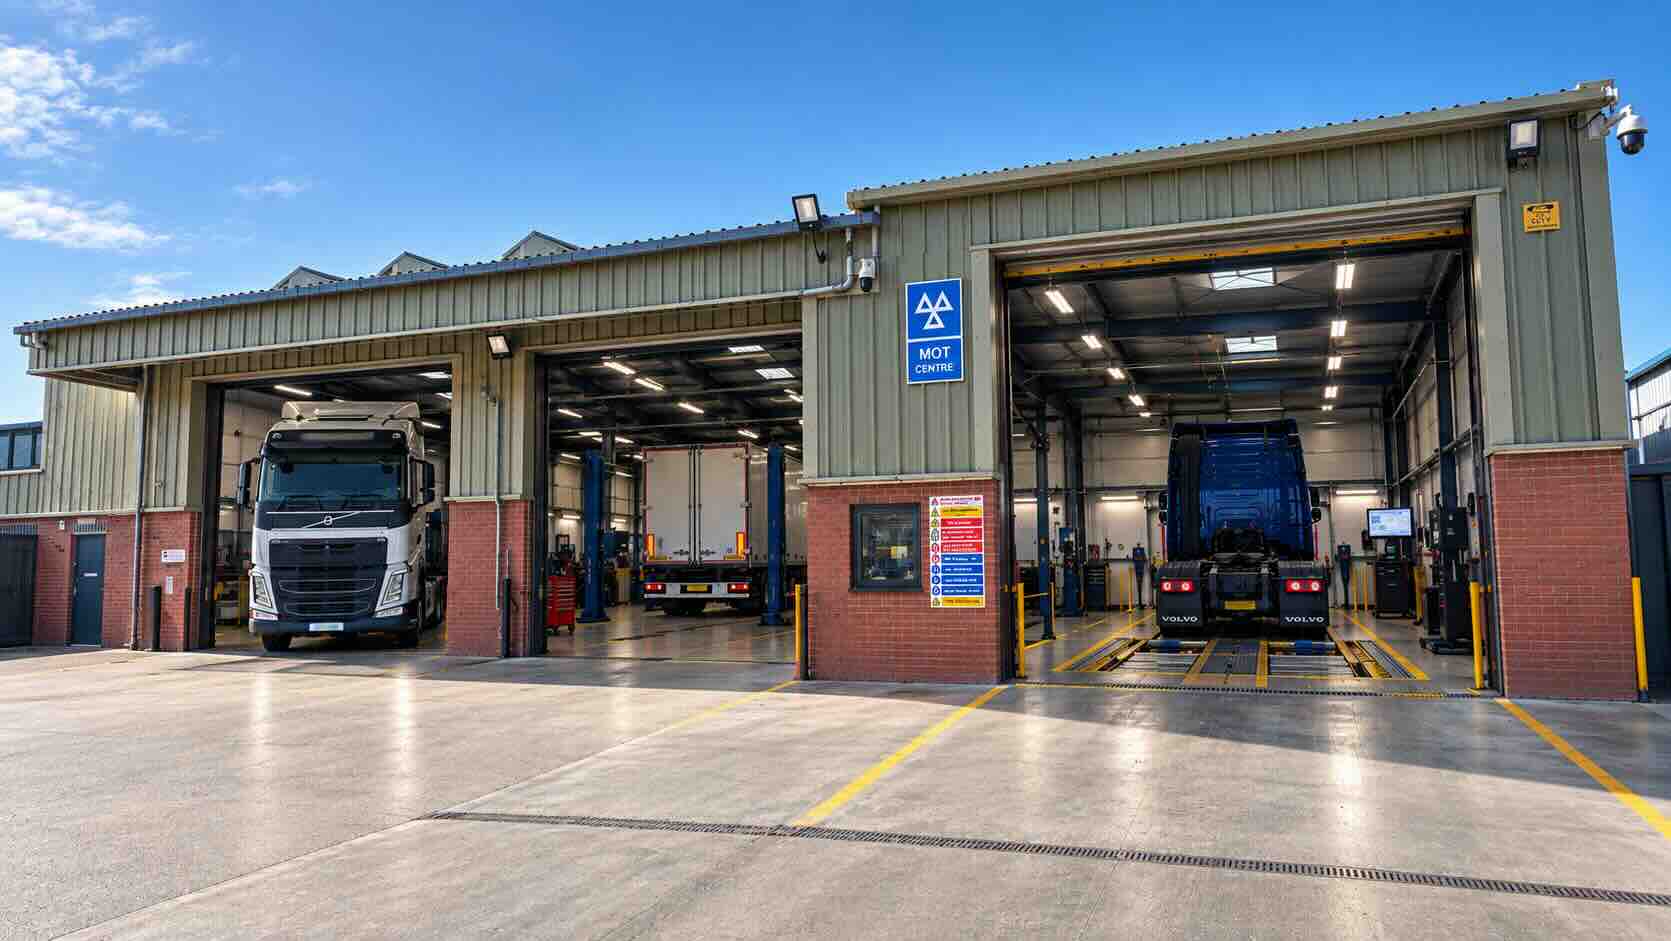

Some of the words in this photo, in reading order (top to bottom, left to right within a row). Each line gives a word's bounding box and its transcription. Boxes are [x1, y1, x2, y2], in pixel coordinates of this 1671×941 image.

[920, 346, 951, 360] MOT
[915, 363, 953, 374] CENTRE
[1161, 615, 1198, 623] VOLVO
